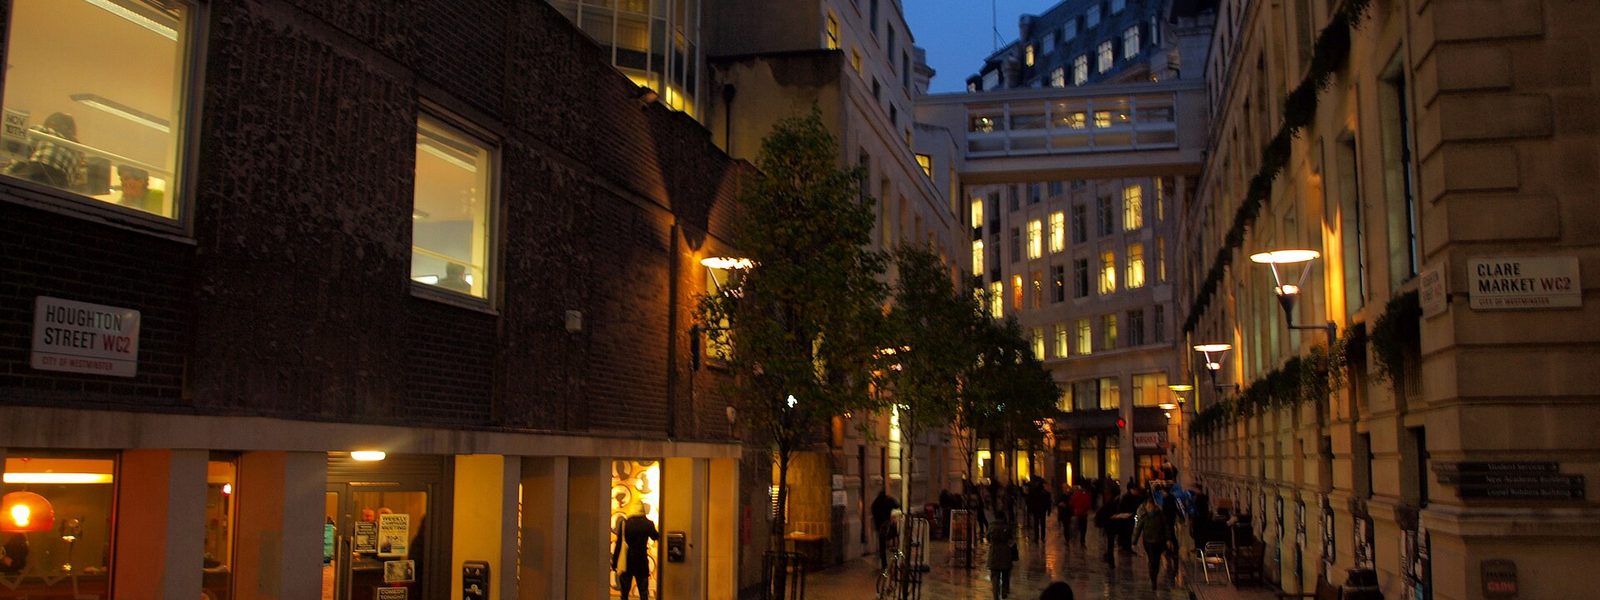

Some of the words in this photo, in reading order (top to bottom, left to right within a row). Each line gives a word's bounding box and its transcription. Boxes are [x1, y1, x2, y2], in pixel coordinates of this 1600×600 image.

[1477, 263, 1521, 277] CLARE
[1478, 278, 1536, 293] MARKET
[1540, 277, 1571, 291] WC2
[46, 304, 122, 331] HOUGHTON
[44, 327, 97, 349] STREET
[103, 334, 130, 353] WC2
[42, 356, 57, 366] CITY
[59, 358, 67, 366] OF
[69, 358, 113, 370] WESTMINSTER
